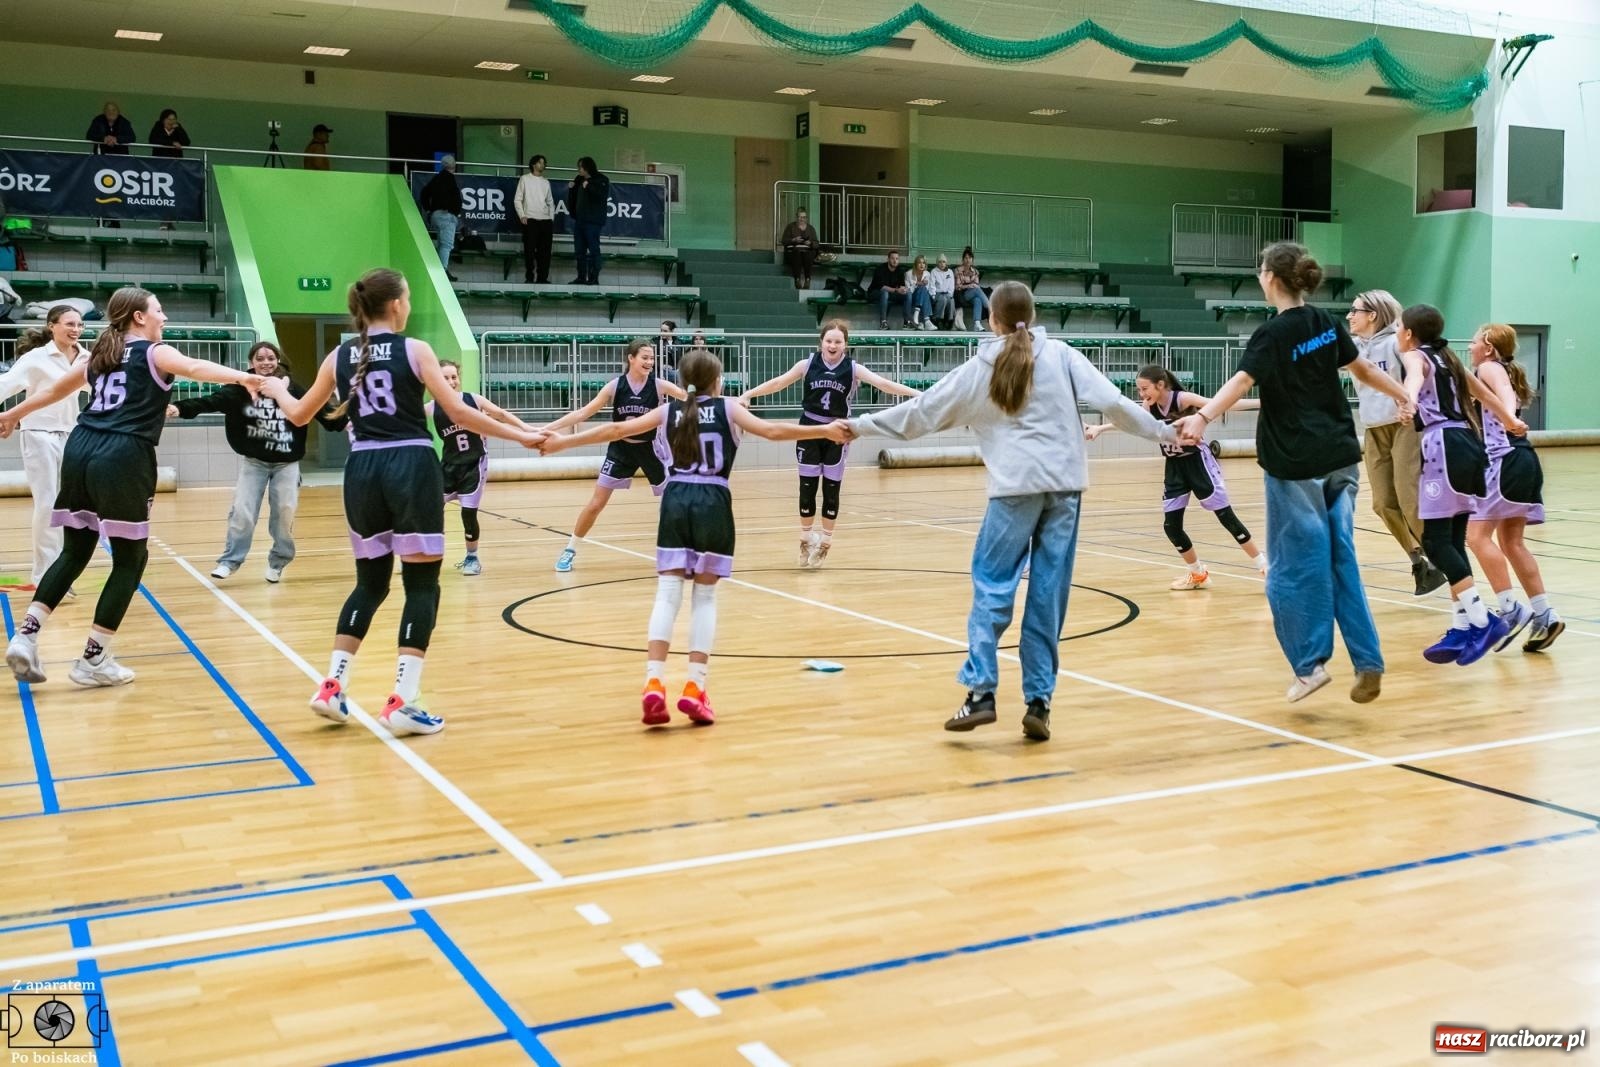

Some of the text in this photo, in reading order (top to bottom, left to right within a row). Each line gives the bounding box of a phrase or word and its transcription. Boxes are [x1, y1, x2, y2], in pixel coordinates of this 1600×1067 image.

[600, 112, 612, 124] F
[620, 113, 627, 125] F
[800, 121, 807, 136] F
[127, 197, 176, 207] RACIBÓRZ
[461, 187, 506, 212] SiR
[465, 212, 507, 221] RACIBÓRZ
[90, 371, 127, 411] 16
[349, 370, 397, 417] 18
[820, 391, 831, 410] 4
[245, 406, 275, 419] ONLY
[256, 418, 278, 431] OUT
[247, 425, 293, 442] THROUGH
[265, 441, 292, 452] IT ALL
[456, 433, 470, 452] 6
